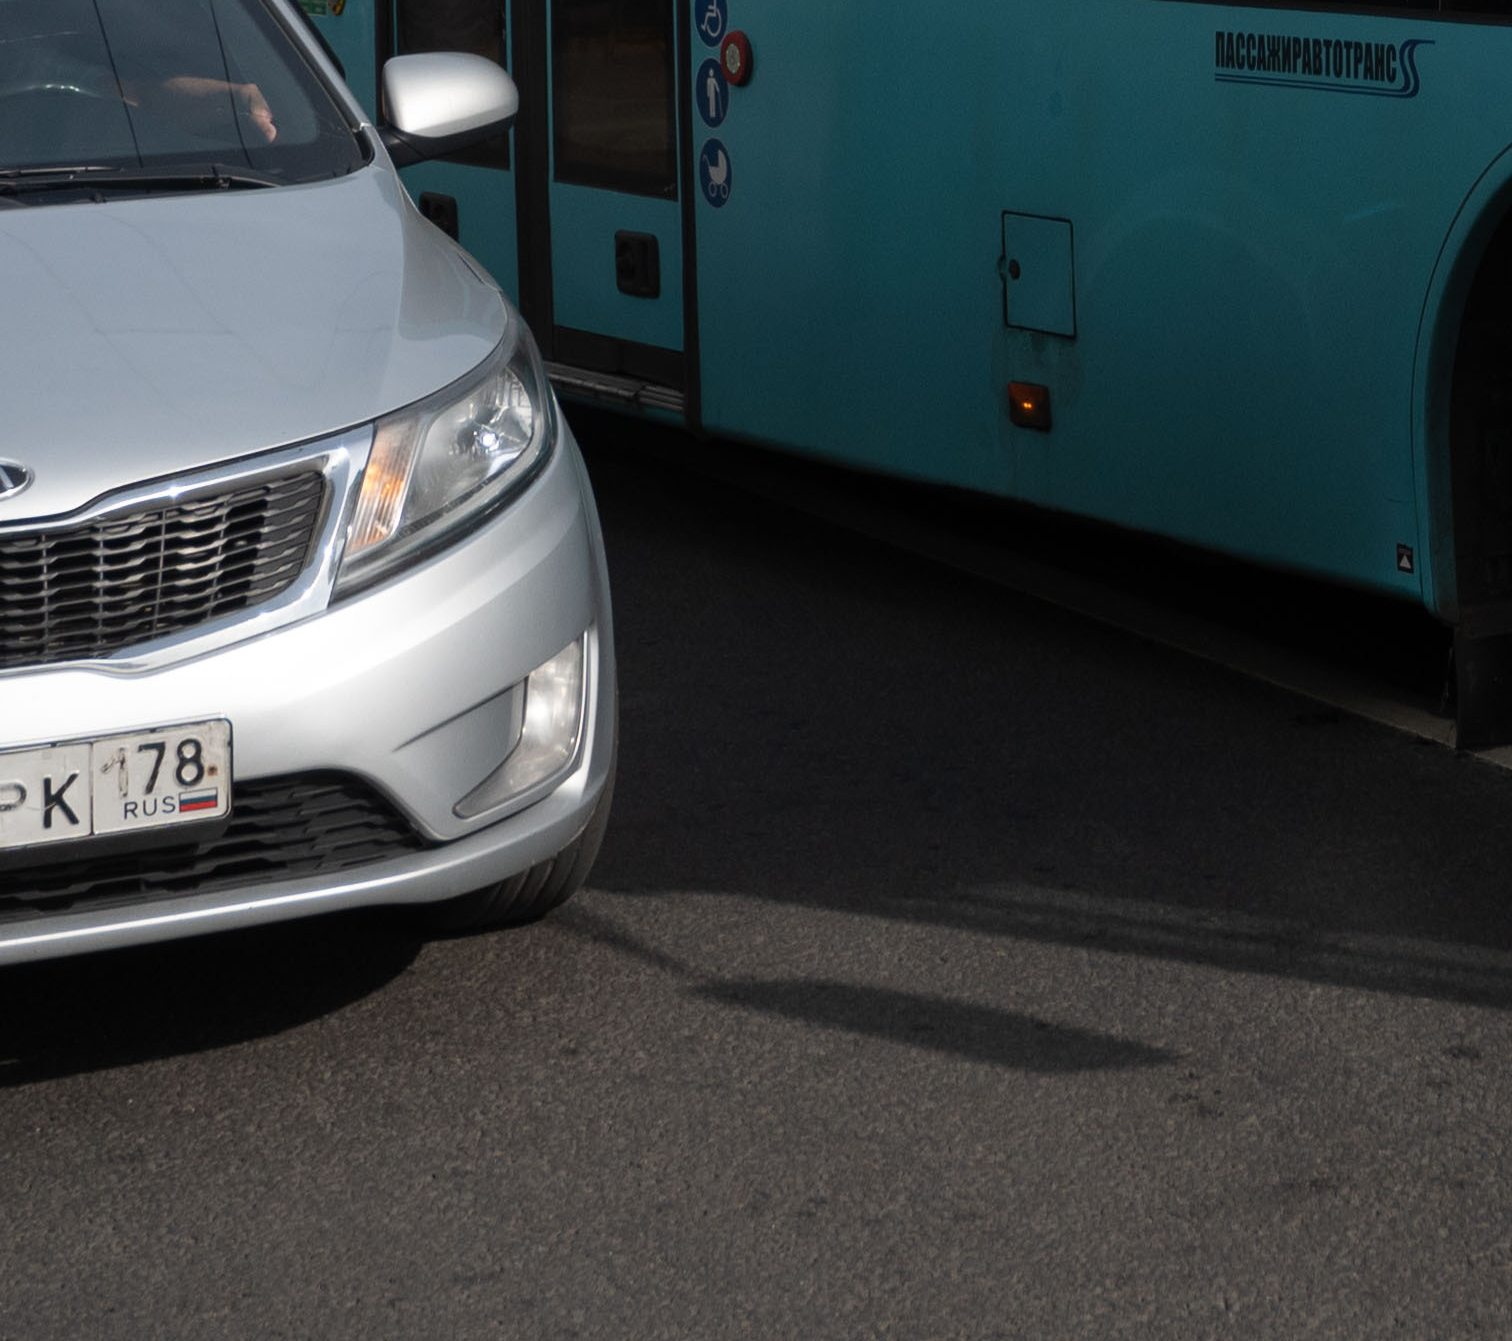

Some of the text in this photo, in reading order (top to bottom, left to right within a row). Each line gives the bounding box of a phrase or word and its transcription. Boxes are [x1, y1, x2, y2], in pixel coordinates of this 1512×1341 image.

[1215, 31, 1397, 83] ПАССАЖИРАВТОТРАНС
[98, 738, 207, 800] 178
[122, 793, 178, 822] RUS
